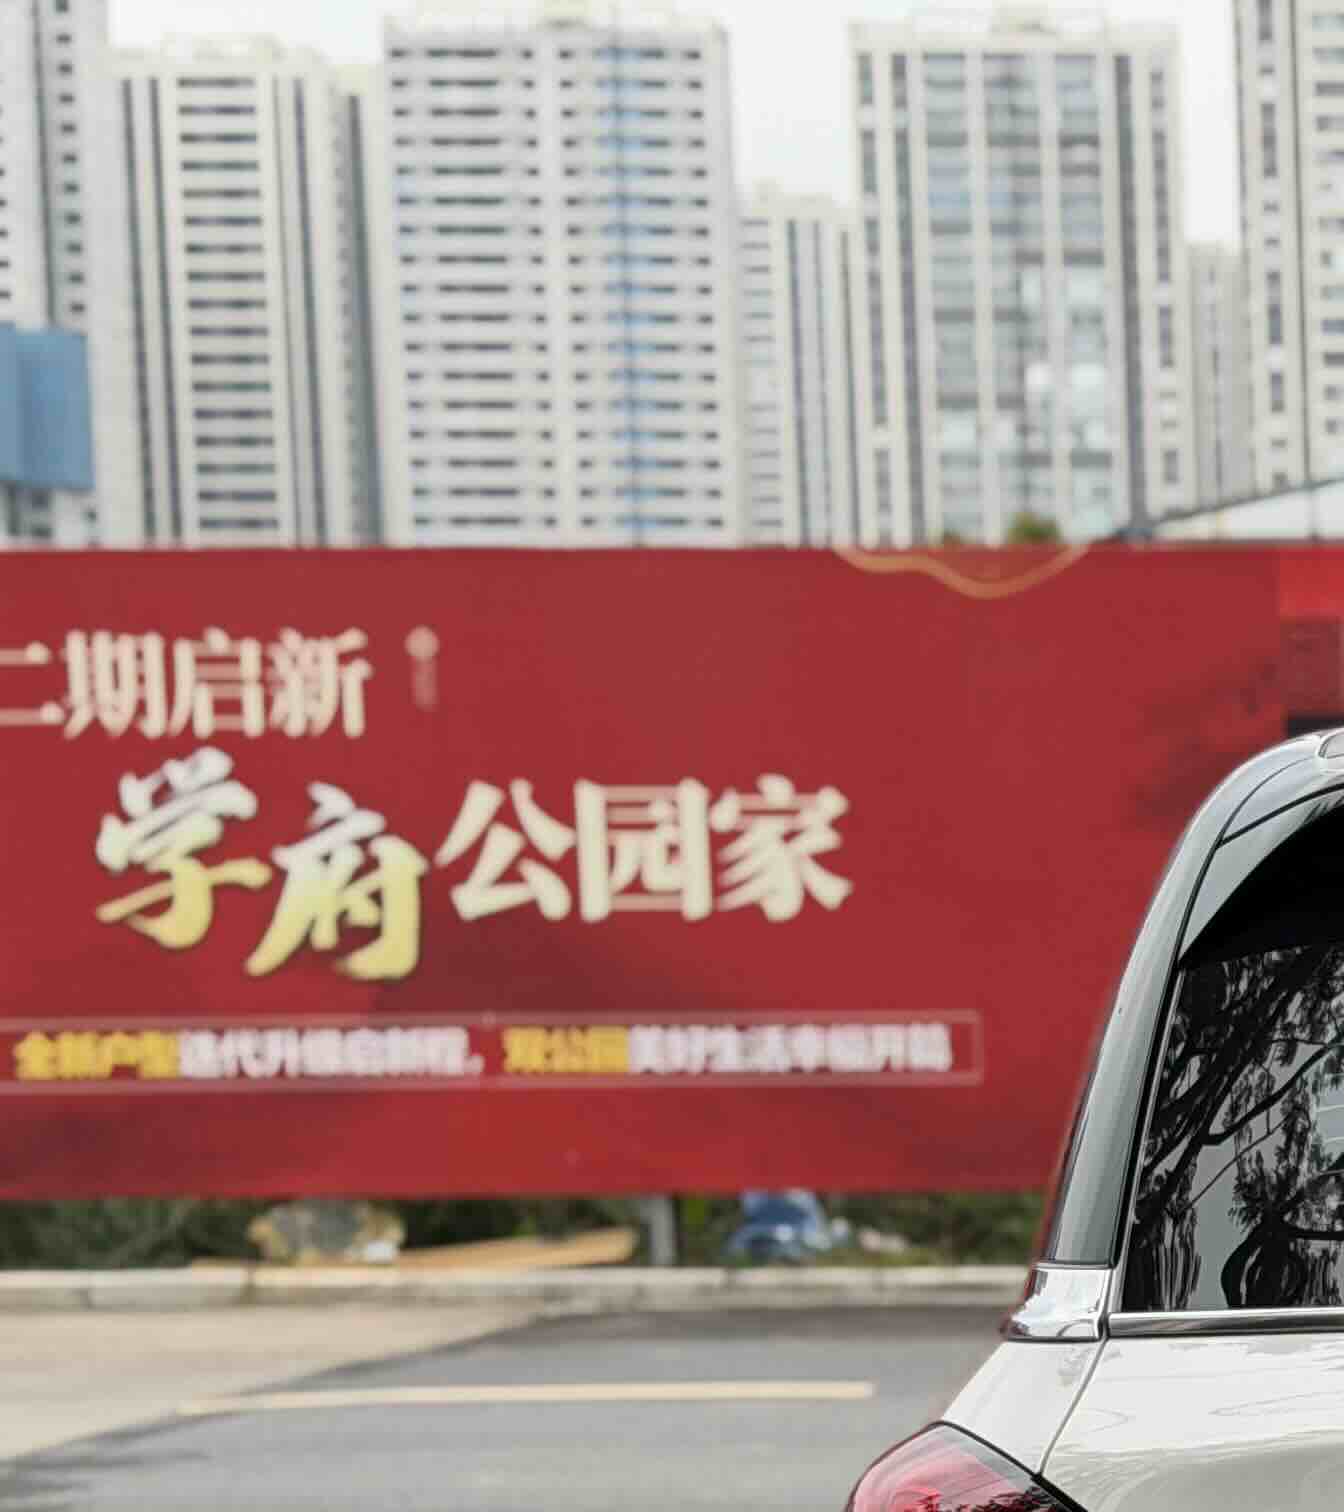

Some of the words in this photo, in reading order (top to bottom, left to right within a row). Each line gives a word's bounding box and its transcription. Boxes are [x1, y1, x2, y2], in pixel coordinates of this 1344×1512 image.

[0, 626, 373, 739] 二期启新
[95, 745, 853, 980] 学府公园家
